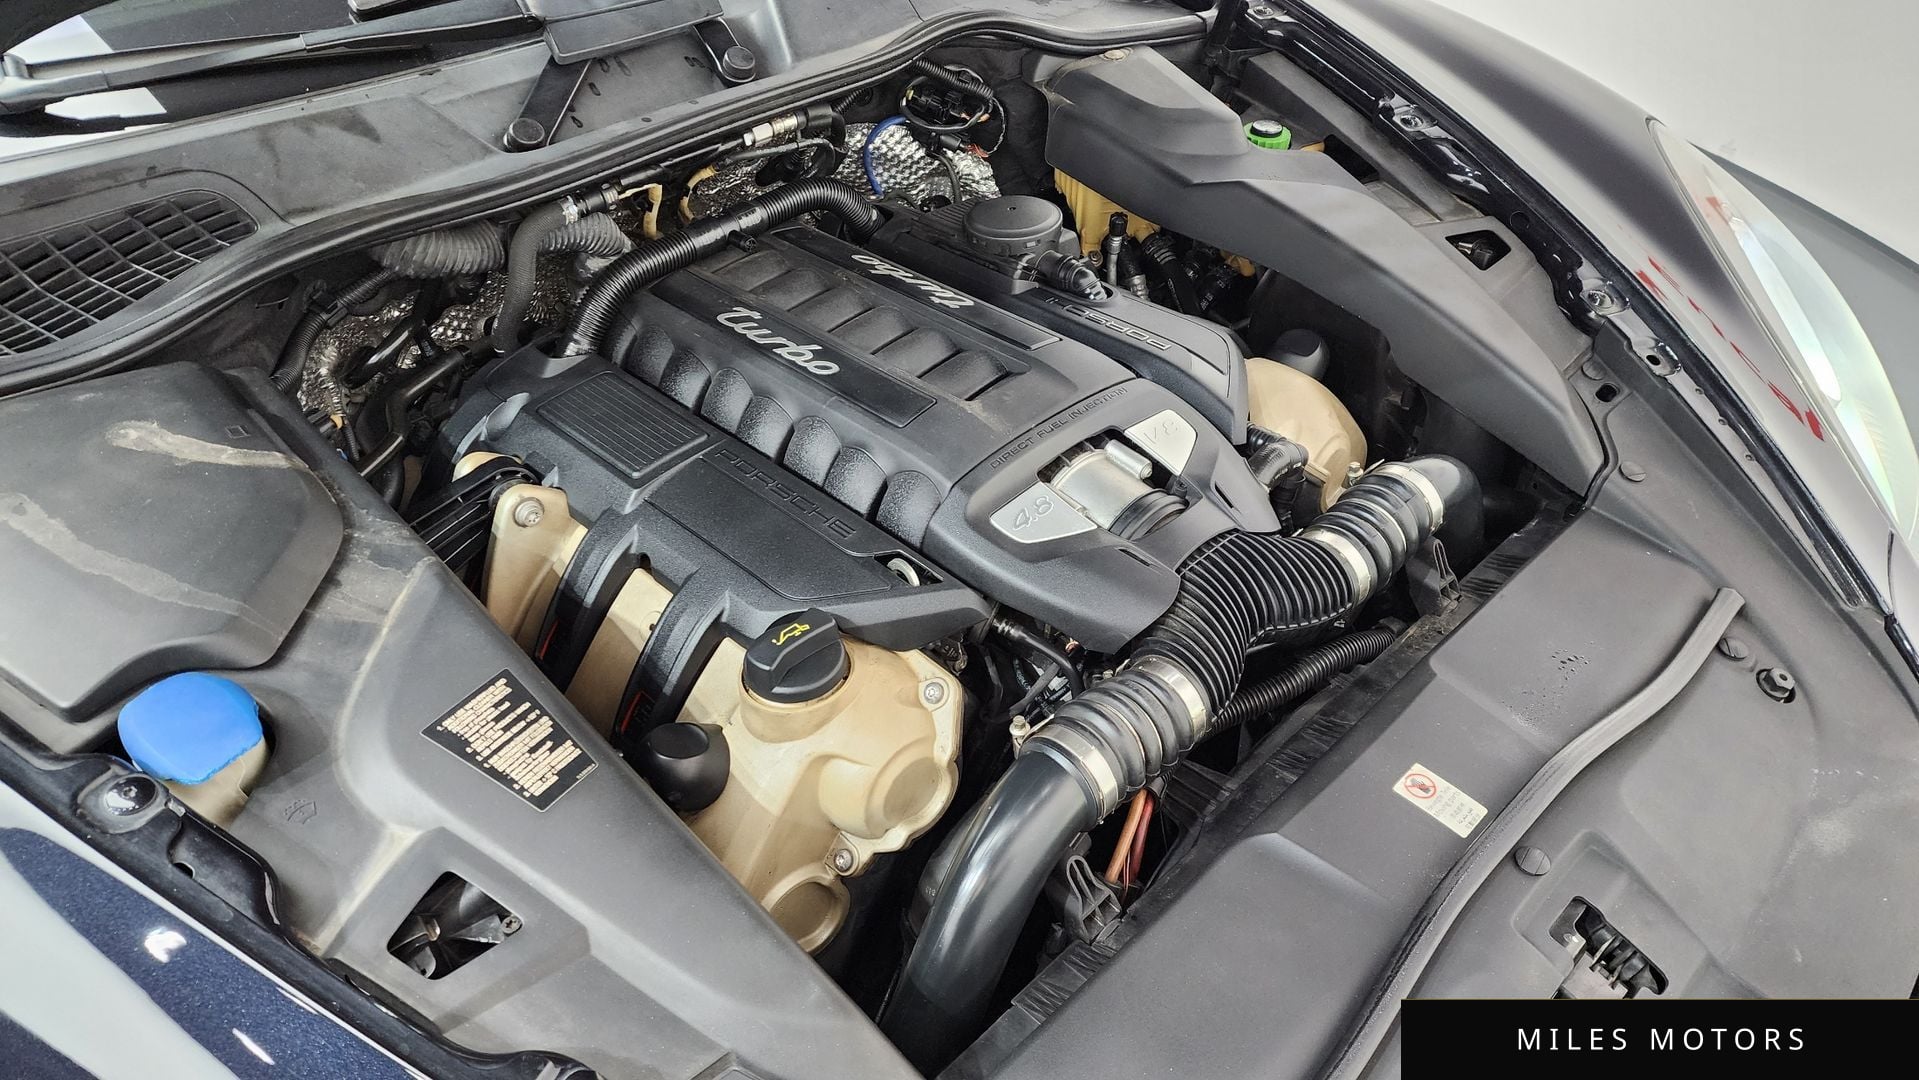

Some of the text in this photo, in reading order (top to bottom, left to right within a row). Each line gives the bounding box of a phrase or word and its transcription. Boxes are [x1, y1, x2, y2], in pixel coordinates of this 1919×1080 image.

[852, 254, 974, 309] turbo
[716, 306, 840, 375] turbo
[989, 387, 1129, 471] DIRECT FUEL INJECTION
[715, 449, 857, 540] PORSCHE
[1011, 494, 1055, 531] 4.8
